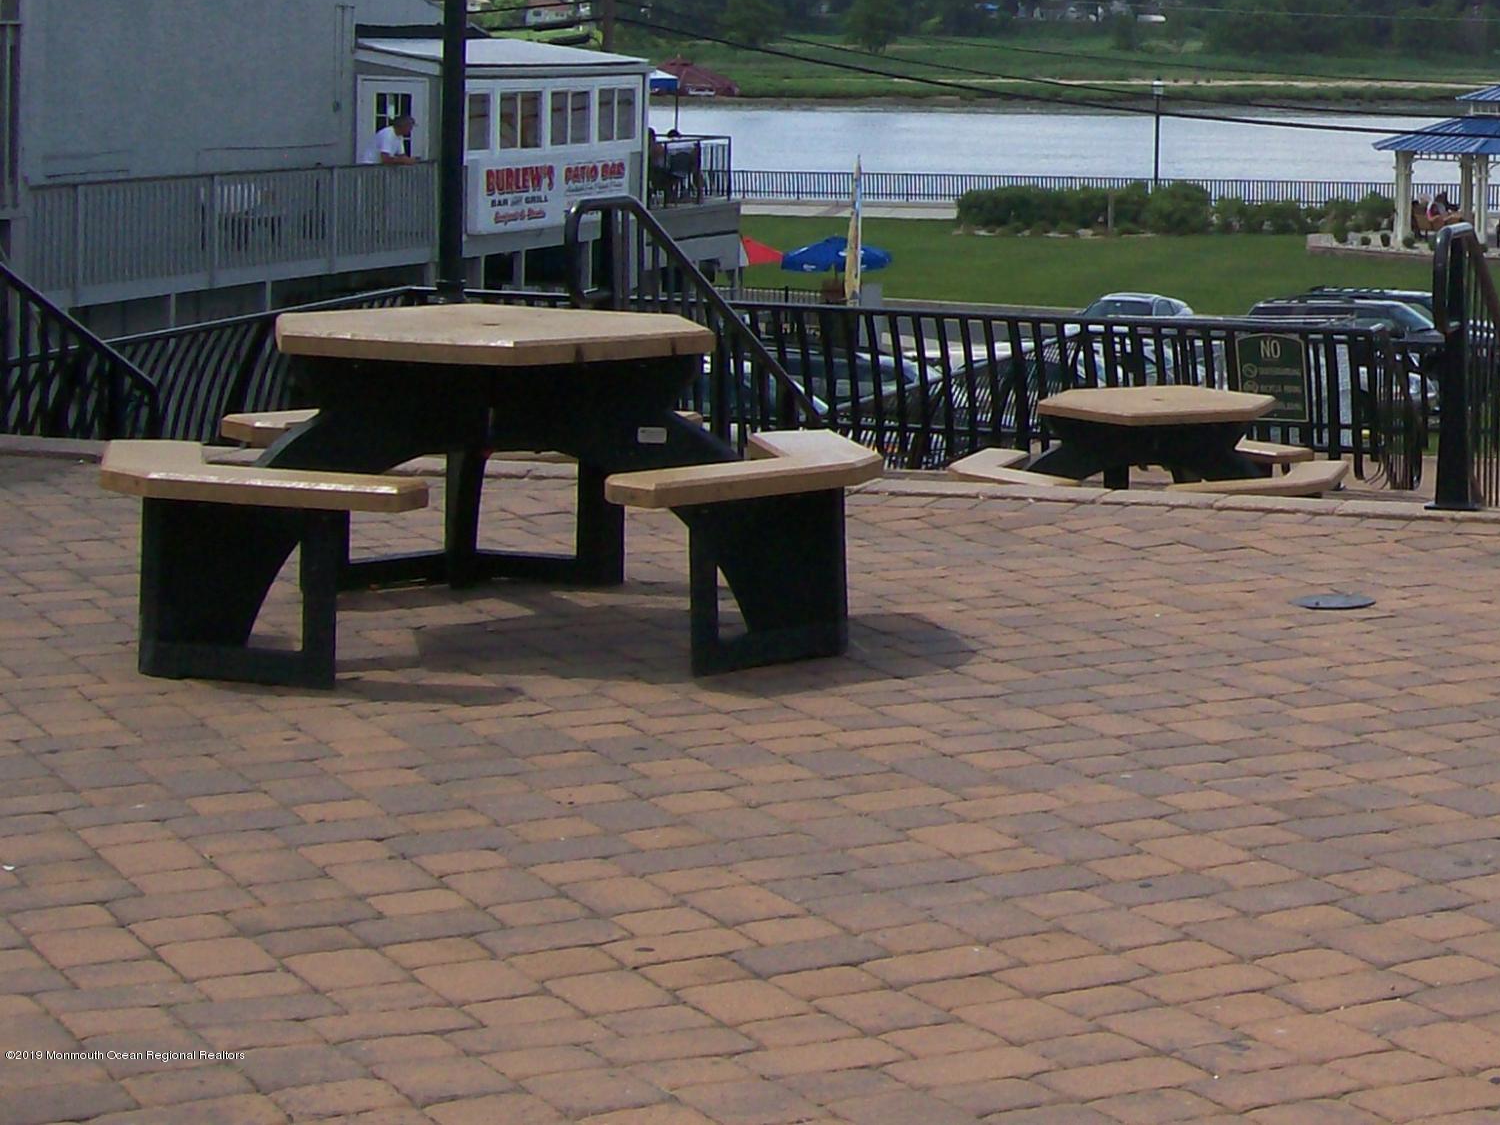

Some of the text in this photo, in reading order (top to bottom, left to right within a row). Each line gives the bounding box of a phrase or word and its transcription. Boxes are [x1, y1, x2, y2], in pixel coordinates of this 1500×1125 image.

[486, 164, 555, 196] BURLEW'S
[564, 161, 626, 185] PATIO BAR
[491, 198, 509, 208] BAR
[525, 195, 549, 204] GRILL
[1260, 339, 1281, 359] NO
